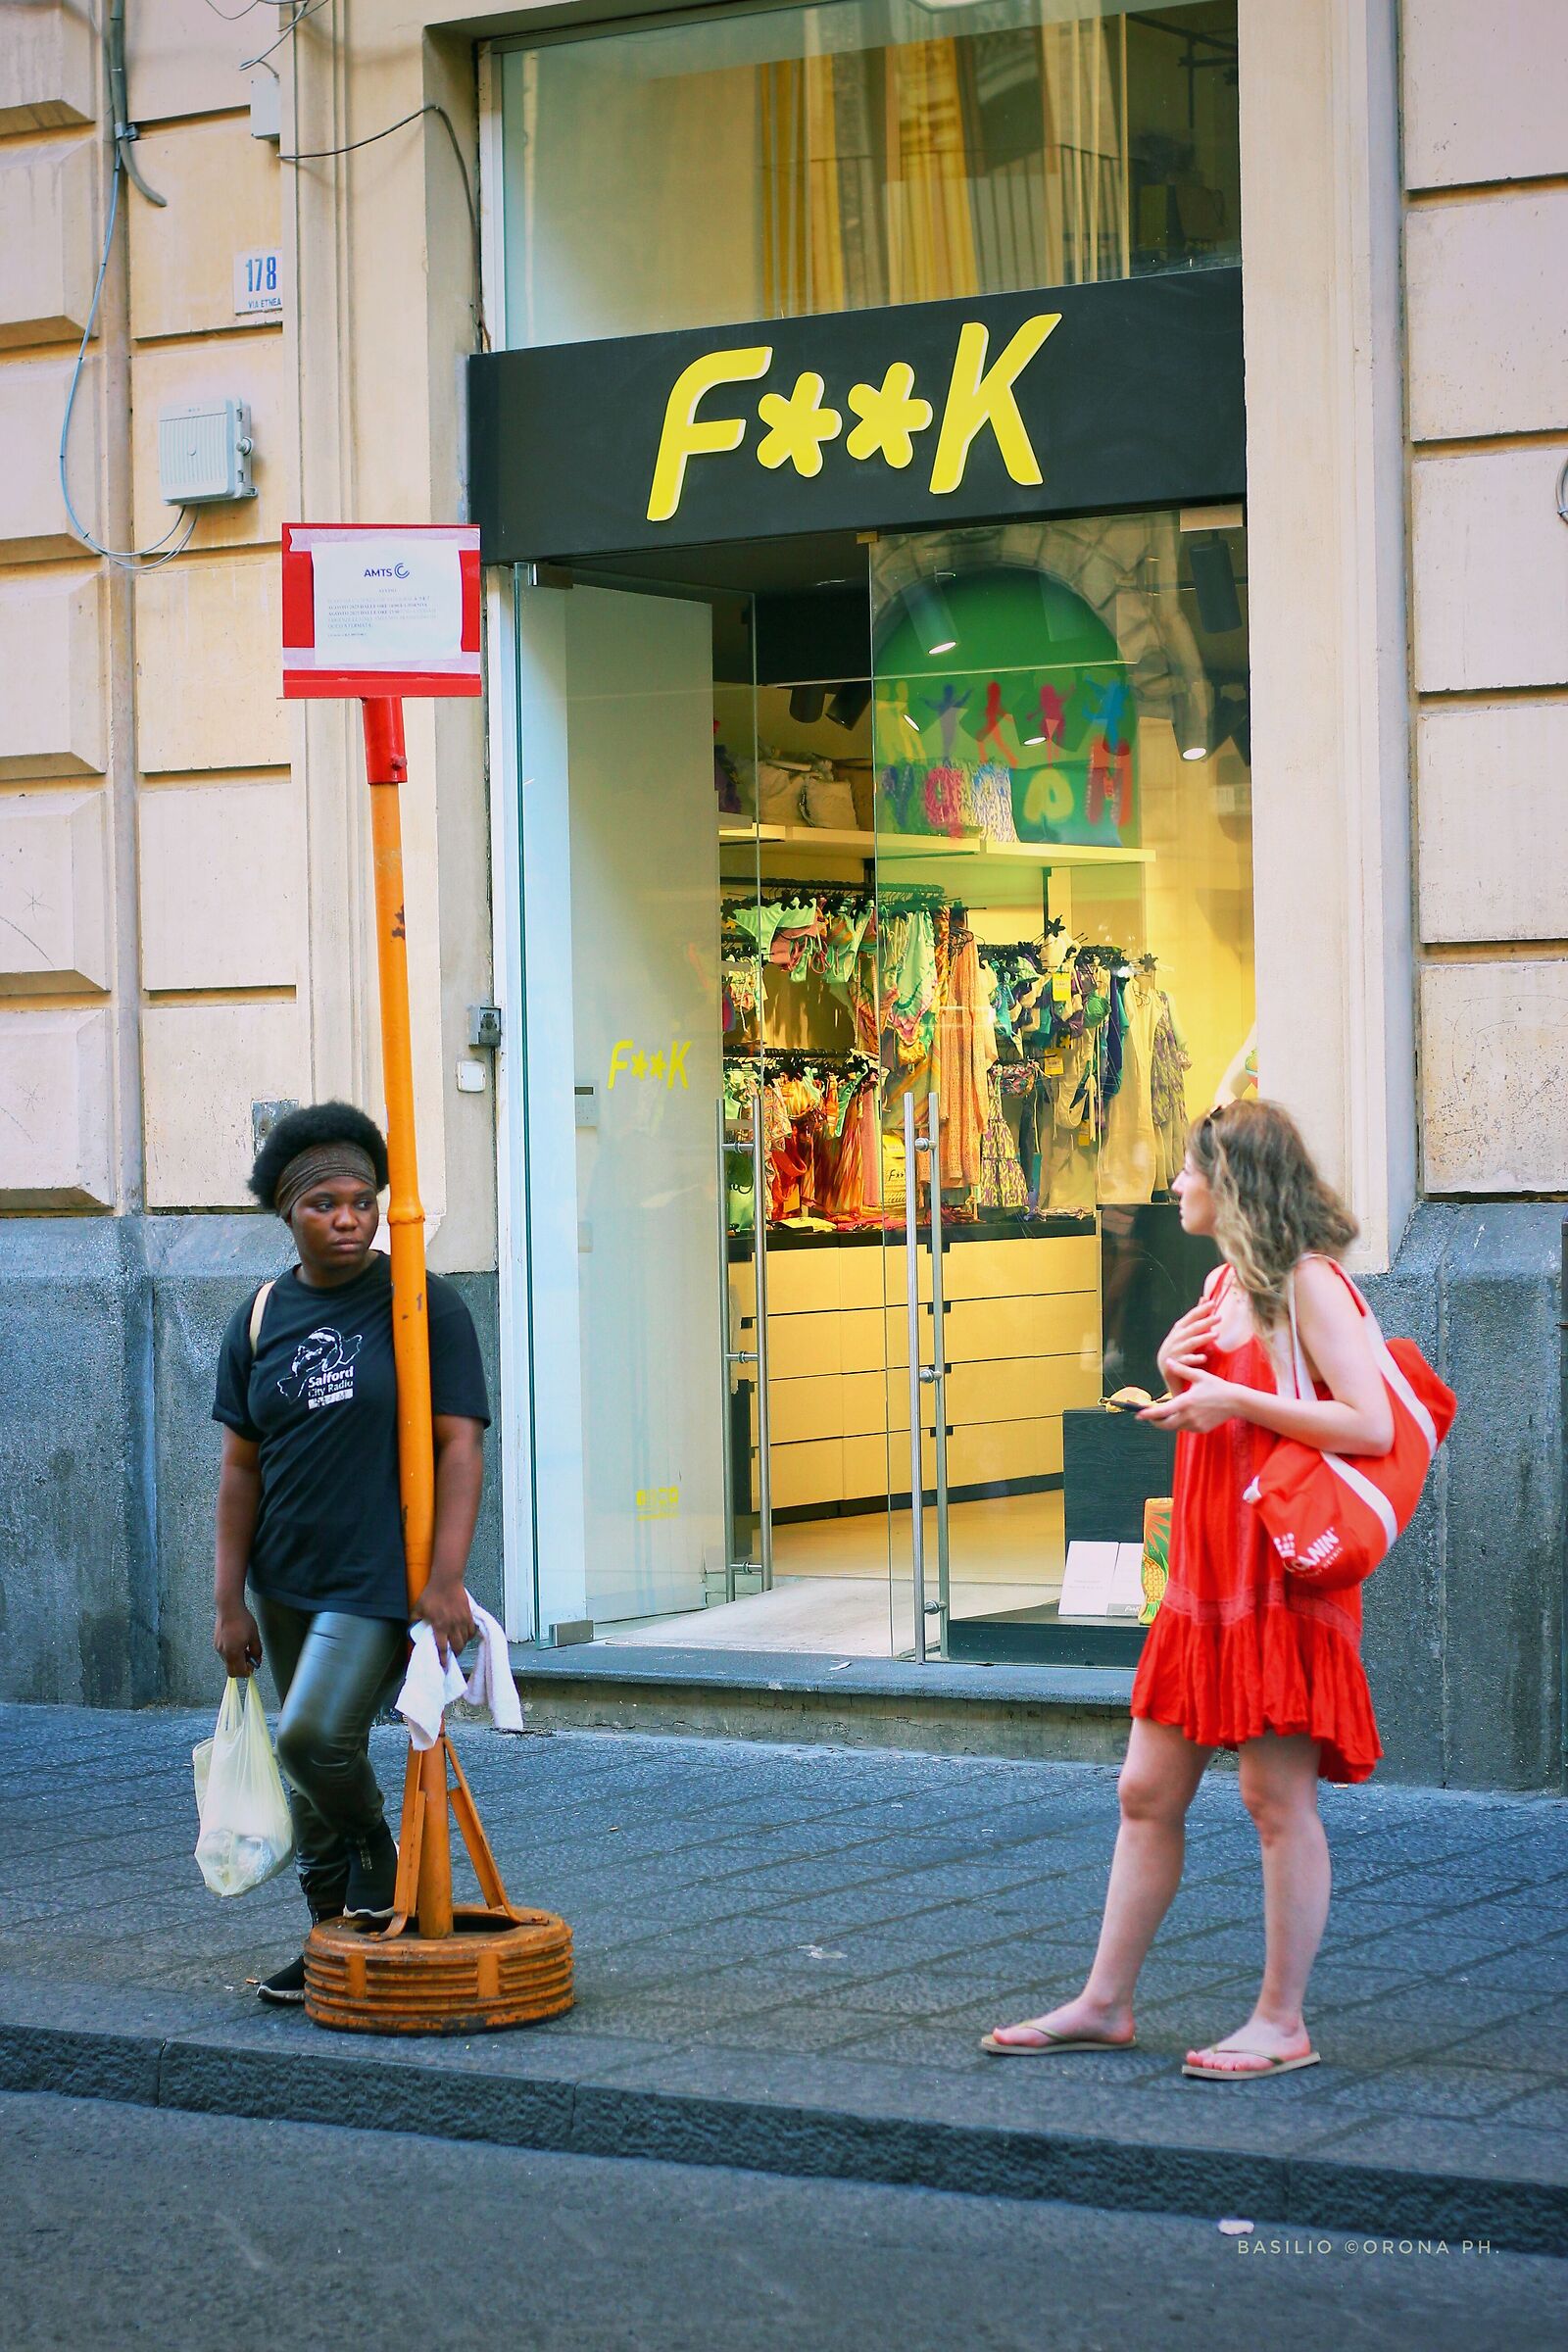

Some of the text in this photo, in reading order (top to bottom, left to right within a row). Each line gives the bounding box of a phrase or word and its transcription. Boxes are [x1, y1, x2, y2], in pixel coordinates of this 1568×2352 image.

[245, 256, 277, 292] 178
[248, 299, 259, 309] VIA
[364, 567, 393, 578] AMTS
[308, 1365, 354, 1389] Salford
[308, 1379, 354, 1398] City Radio
